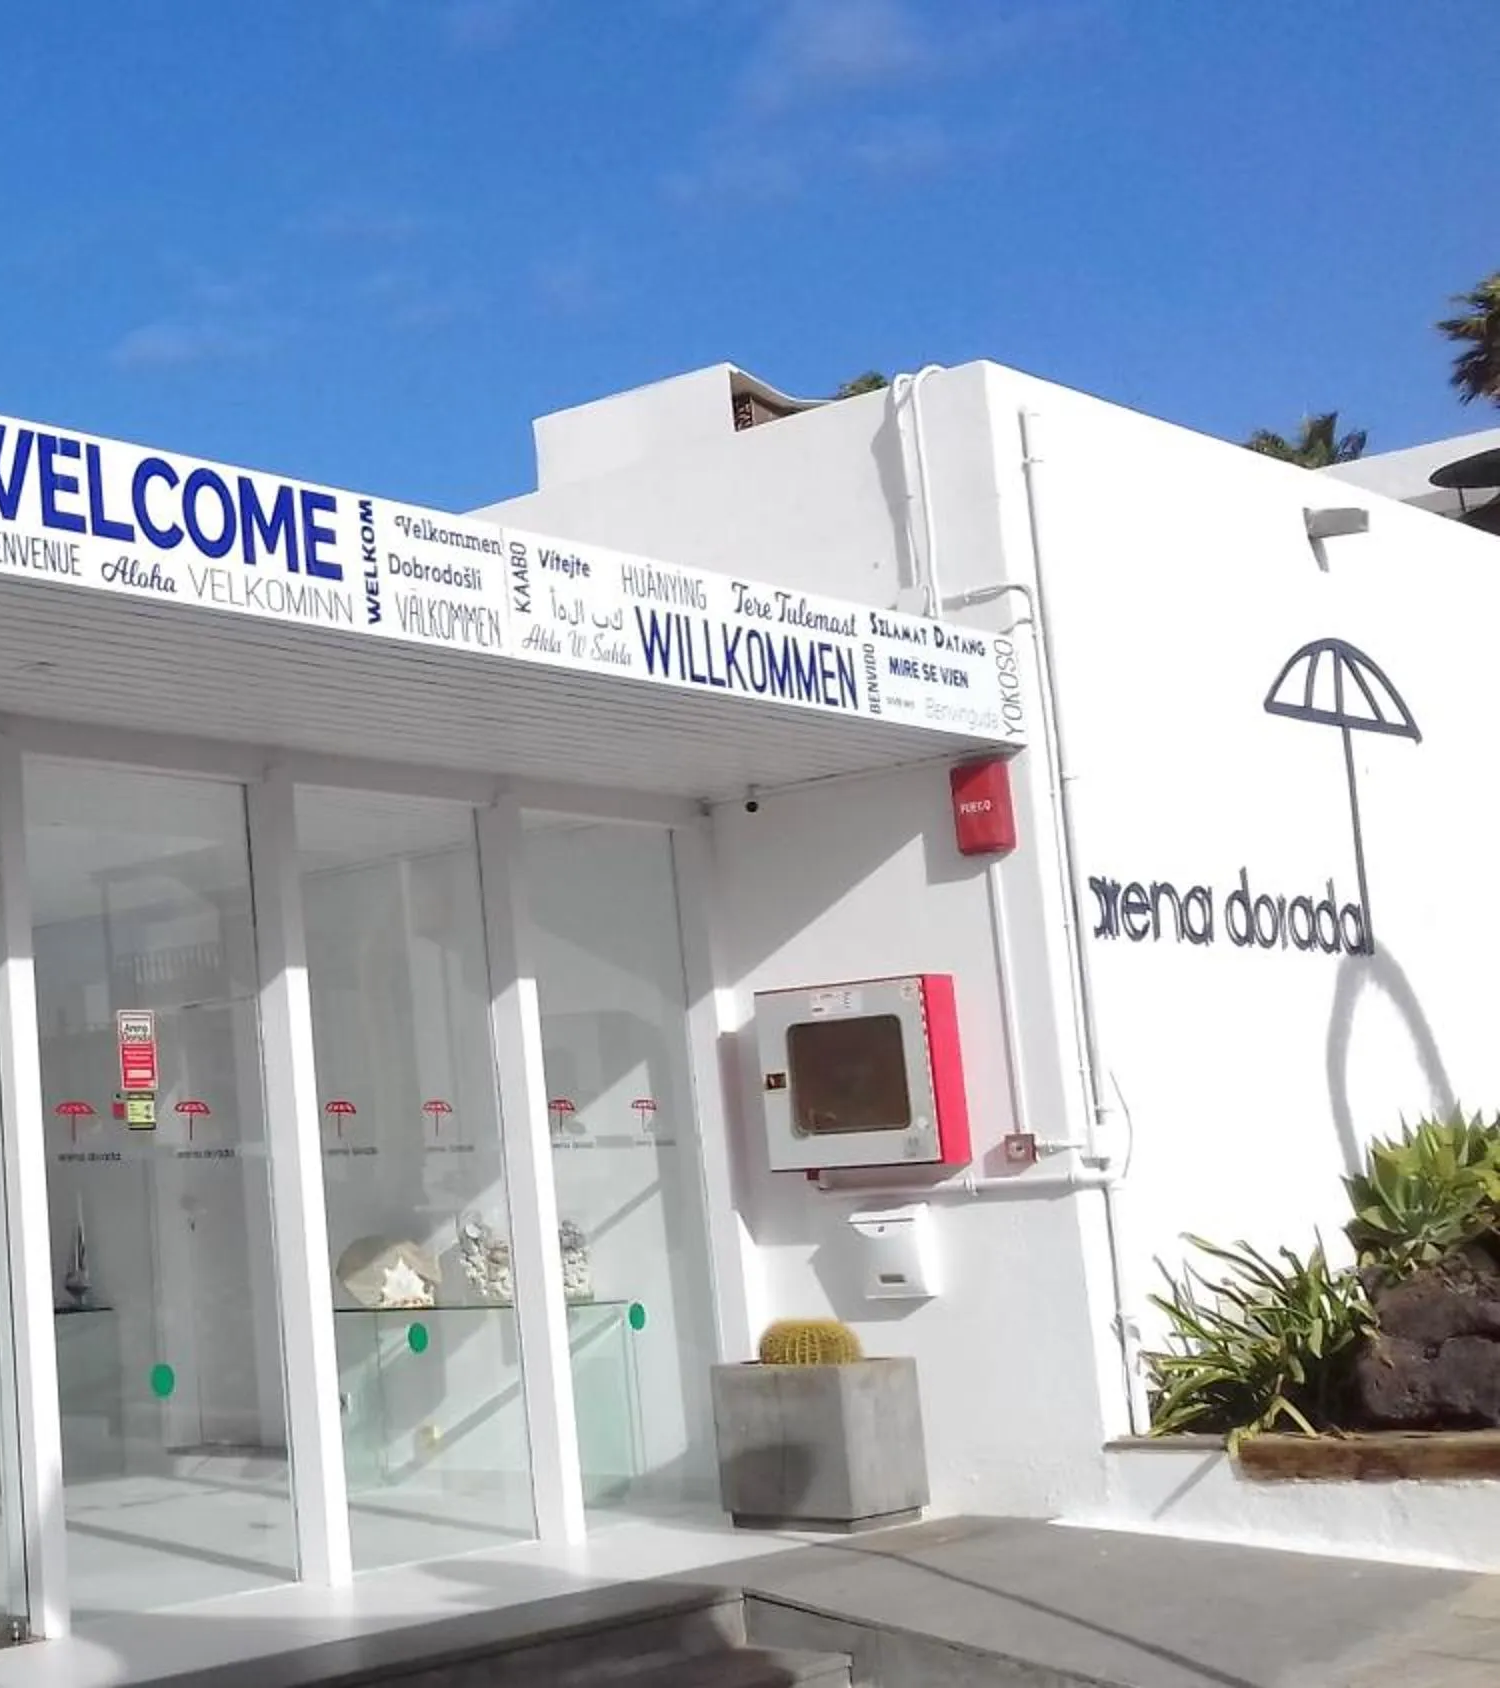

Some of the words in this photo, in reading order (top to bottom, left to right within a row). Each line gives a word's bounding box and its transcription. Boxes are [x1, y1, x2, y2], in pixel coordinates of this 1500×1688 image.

[358, 499, 383, 625] WELKOM
[394, 514, 503, 556] Velkommen
[101, 555, 178, 593] Aloha
[187, 563, 353, 624] VELKOMINN
[387, 552, 483, 591] Dobrodošli
[731, 581, 773, 622] Tere
[773, 590, 859, 638] Tulemast
[633, 604, 860, 711] WILLKOMMEN
[993, 638, 1026, 737] YOKOSO
[1224, 865, 1369, 957] dorada
